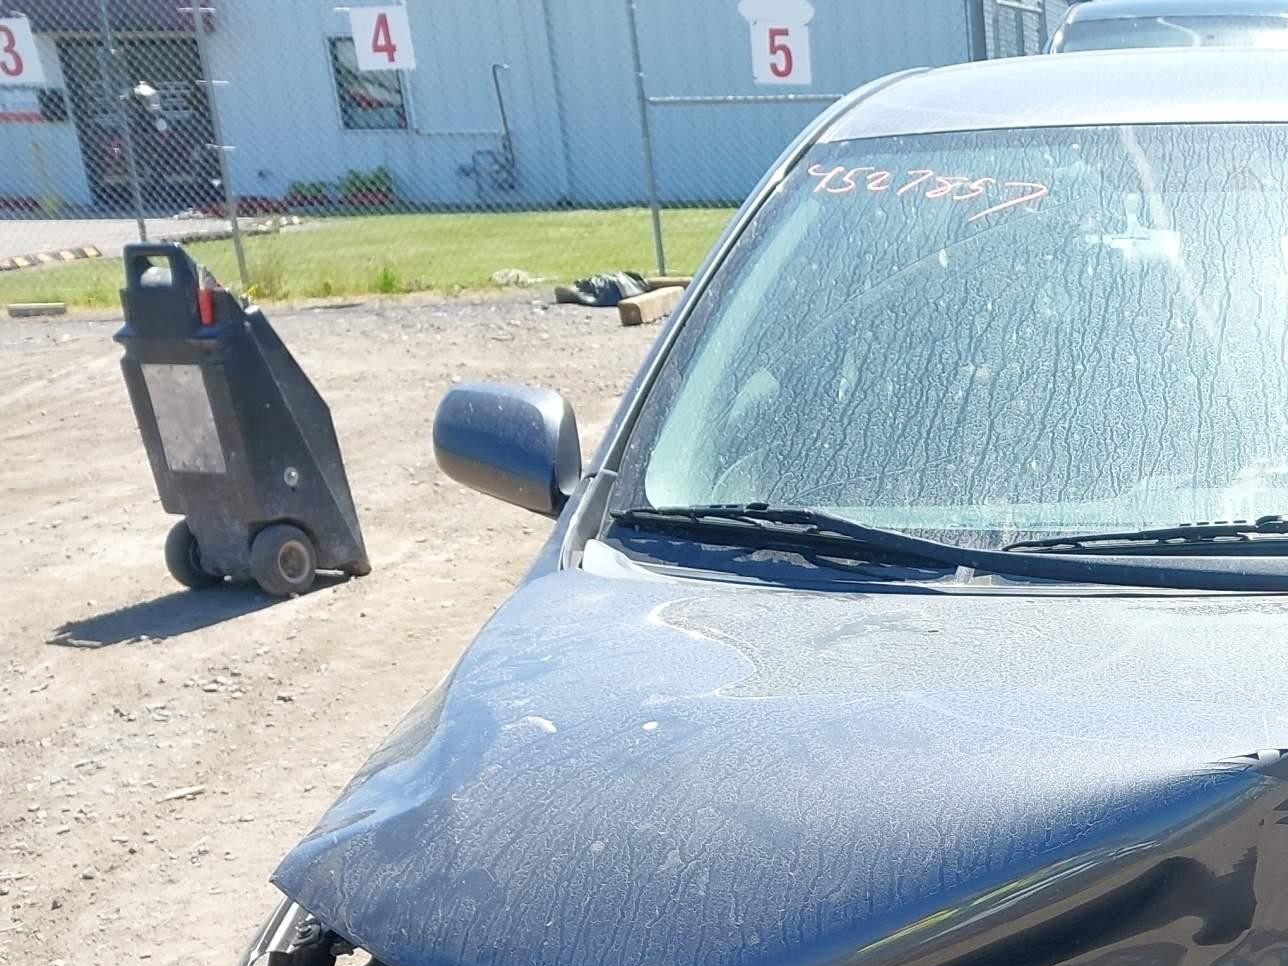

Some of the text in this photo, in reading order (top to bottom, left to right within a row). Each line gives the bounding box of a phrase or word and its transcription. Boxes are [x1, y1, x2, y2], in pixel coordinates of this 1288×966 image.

[0, 24, 24, 77] 3
[371, 12, 398, 63] 4
[767, 27, 794, 78] 5
